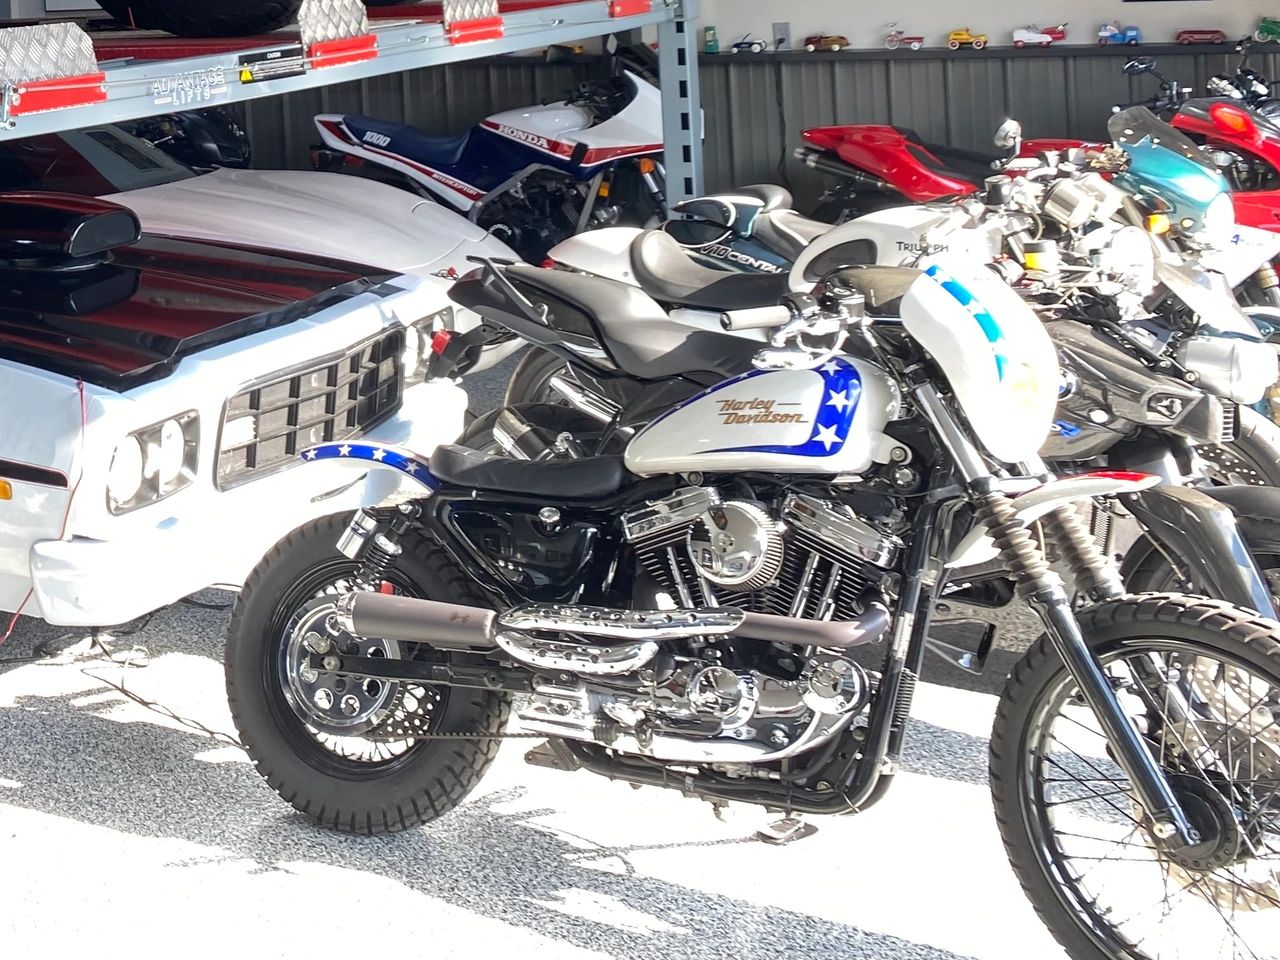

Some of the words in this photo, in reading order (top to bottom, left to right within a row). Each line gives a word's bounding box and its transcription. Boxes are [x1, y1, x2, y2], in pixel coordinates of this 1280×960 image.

[152, 66, 225, 95] ADVANTAGE
[172, 86, 210, 105] LIFTS
[363, 131, 391, 147] 1000
[498, 125, 549, 149] HONDA
[896, 241, 949, 253] TRIUPH
[727, 251, 790, 274] CENTAU
[716, 398, 776, 413] Harley
[718, 411, 808, 425] Davidson
